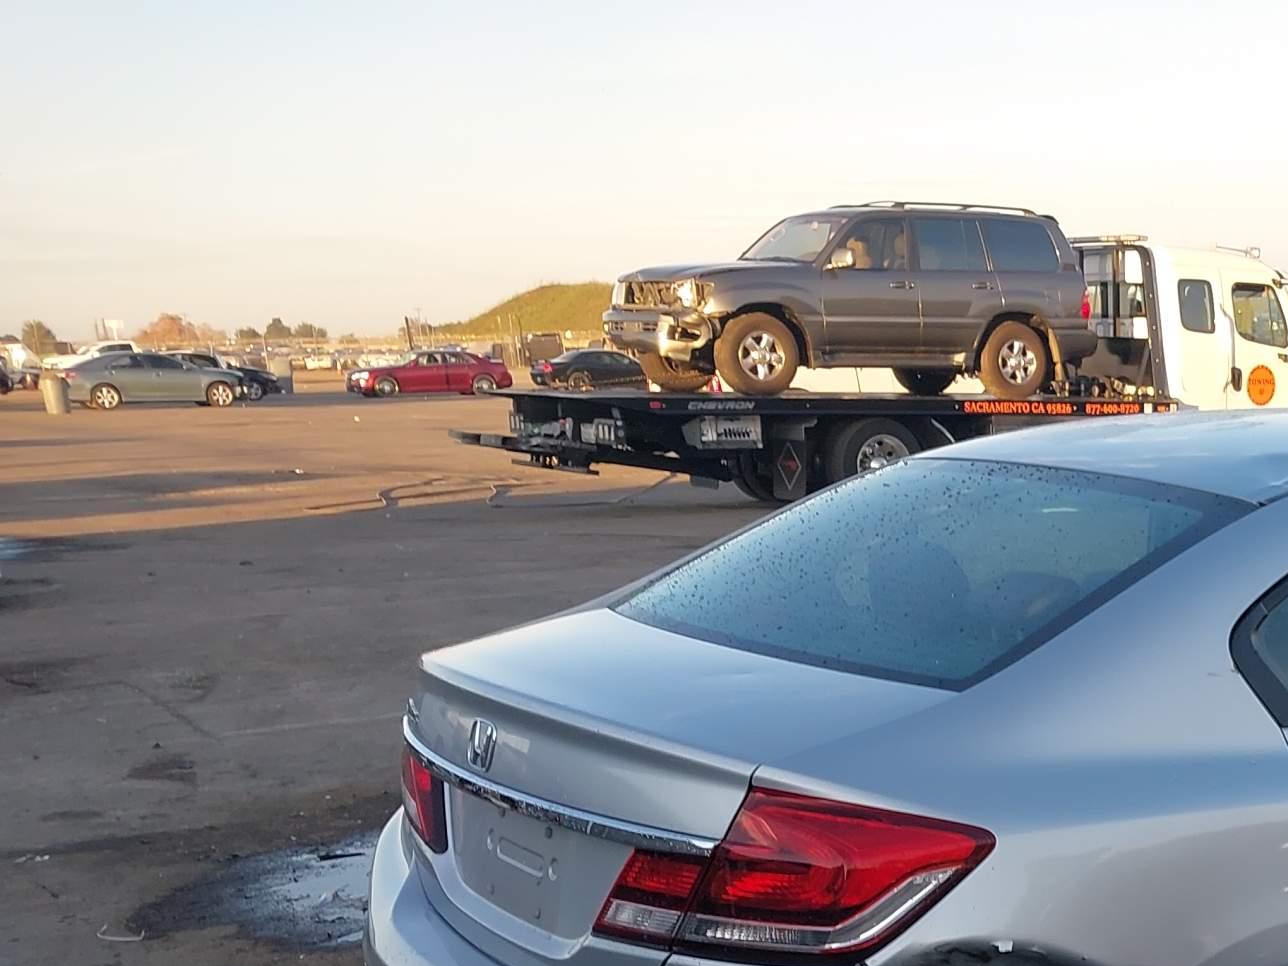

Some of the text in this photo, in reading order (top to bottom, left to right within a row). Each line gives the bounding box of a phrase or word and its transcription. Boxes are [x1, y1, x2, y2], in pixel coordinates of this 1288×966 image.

[687, 401, 756, 410] CHEVRON
[964, 401, 1030, 413] SACRAMENTO
[1031, 402, 1045, 414] CA
[1046, 402, 1073, 415] 95826
